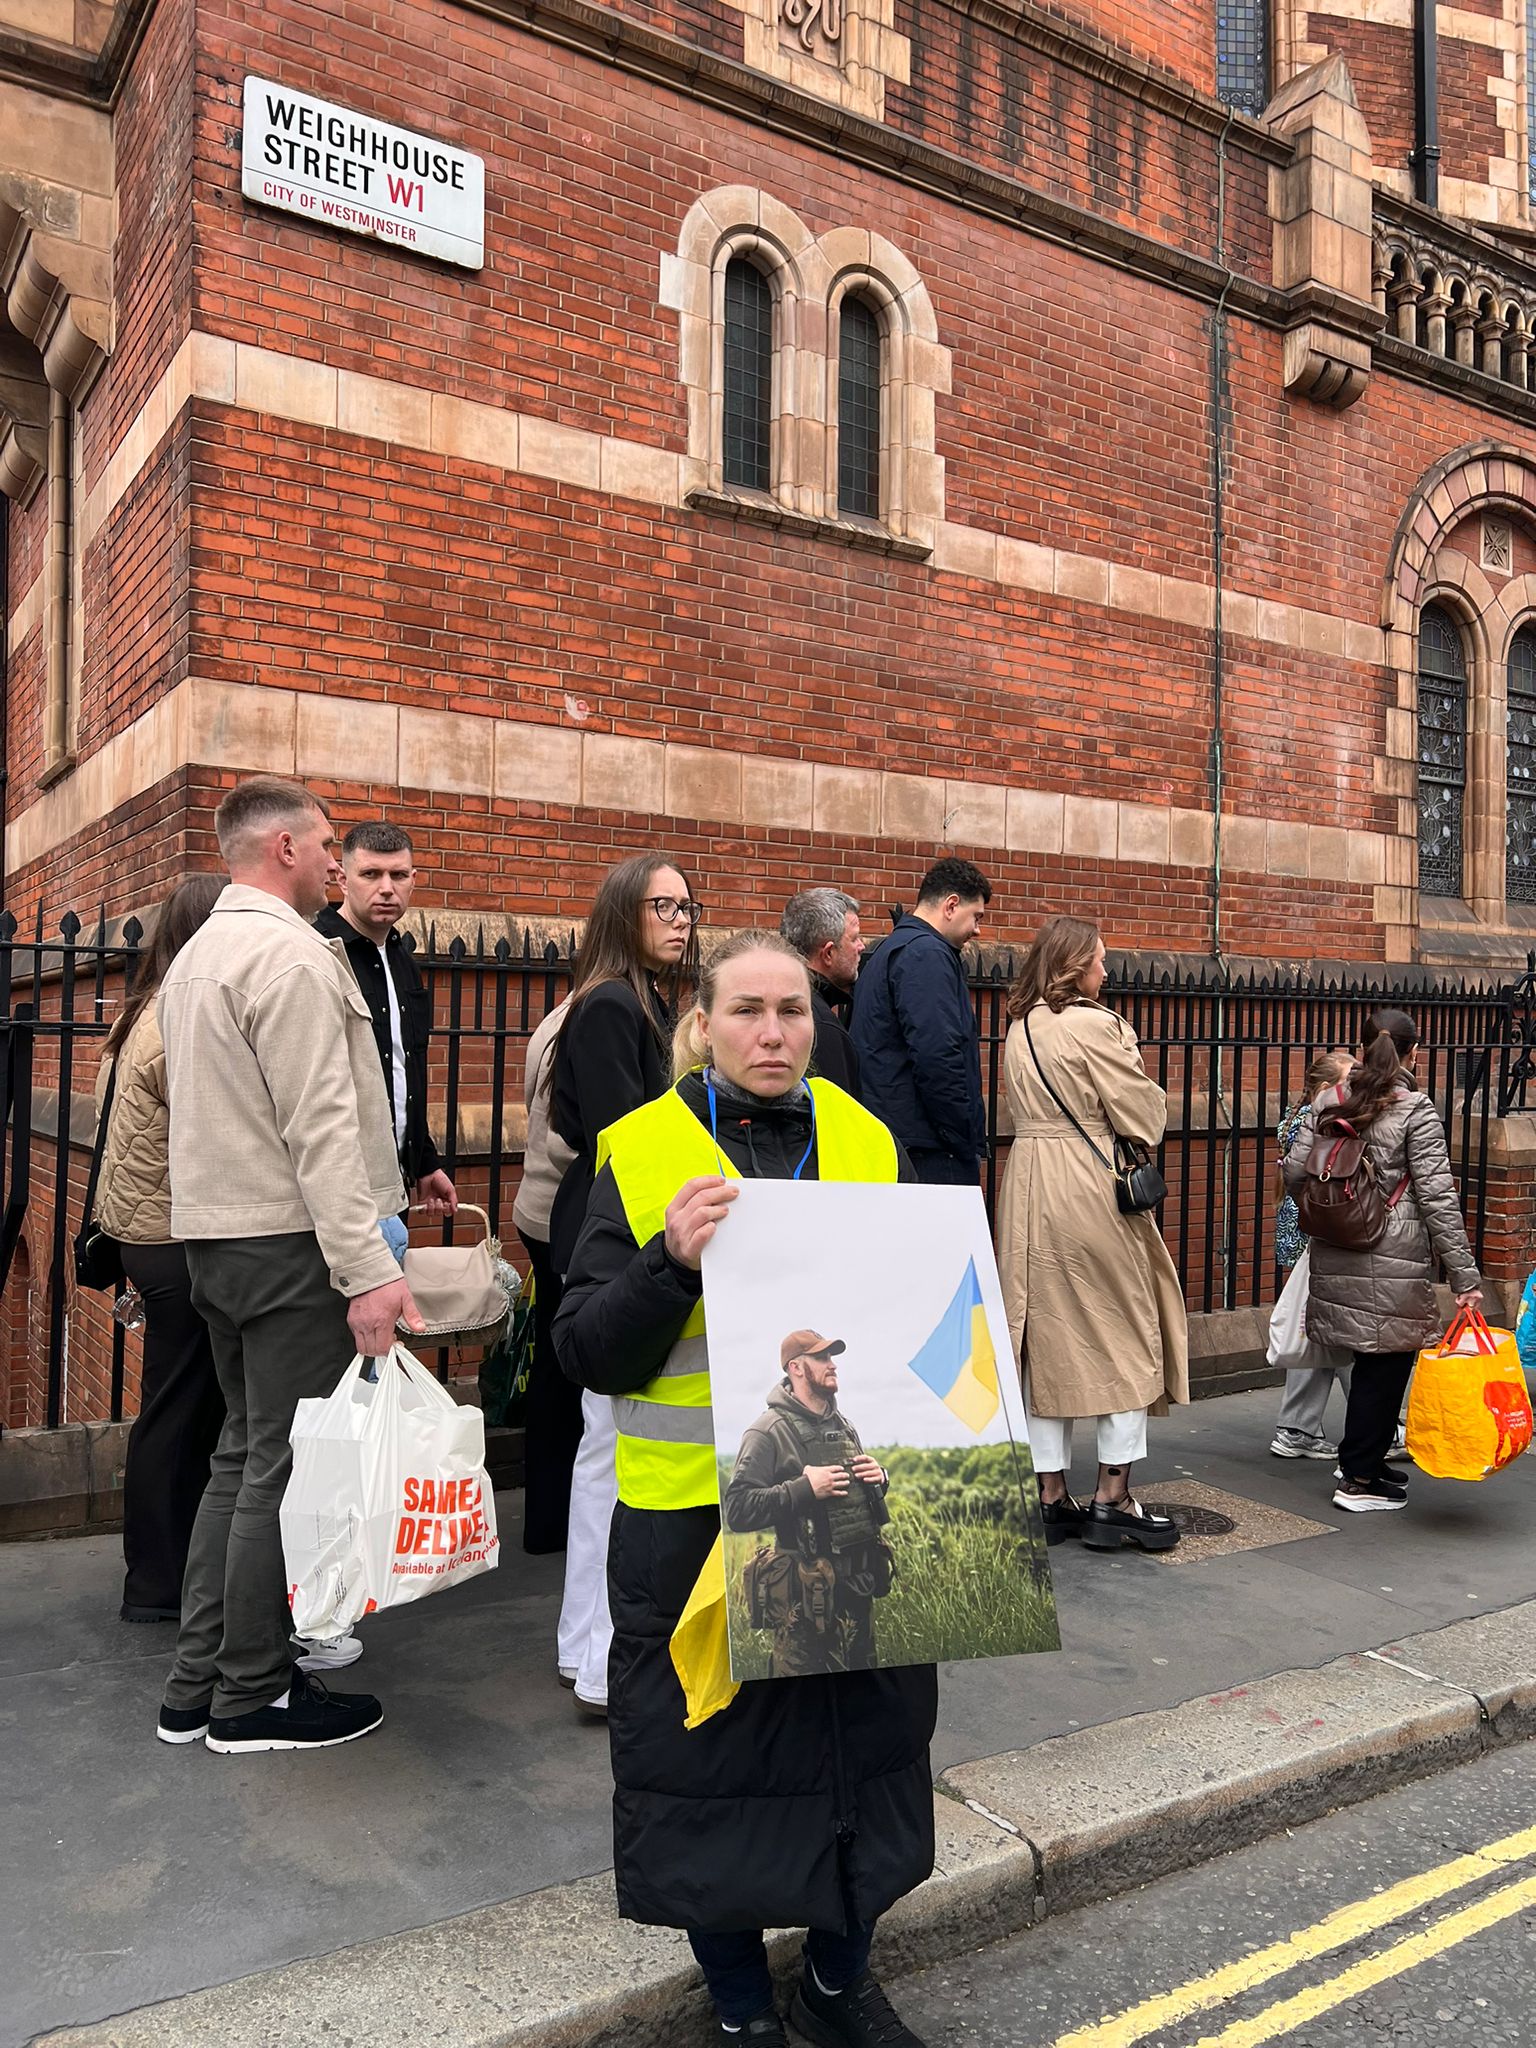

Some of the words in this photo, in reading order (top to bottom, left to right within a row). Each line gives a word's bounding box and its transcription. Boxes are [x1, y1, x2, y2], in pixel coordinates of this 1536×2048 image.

[264, 133, 375, 195] STREET
[387, 173, 424, 213] W1
[265, 94, 465, 191] WEIGHHOUSE
[263, 181, 295, 203] CITY
[300, 193, 317, 210] OF
[321, 199, 417, 243] WESTMINSTER
[404, 1477, 474, 1514] SAME
[436, 1563, 446, 1574] at
